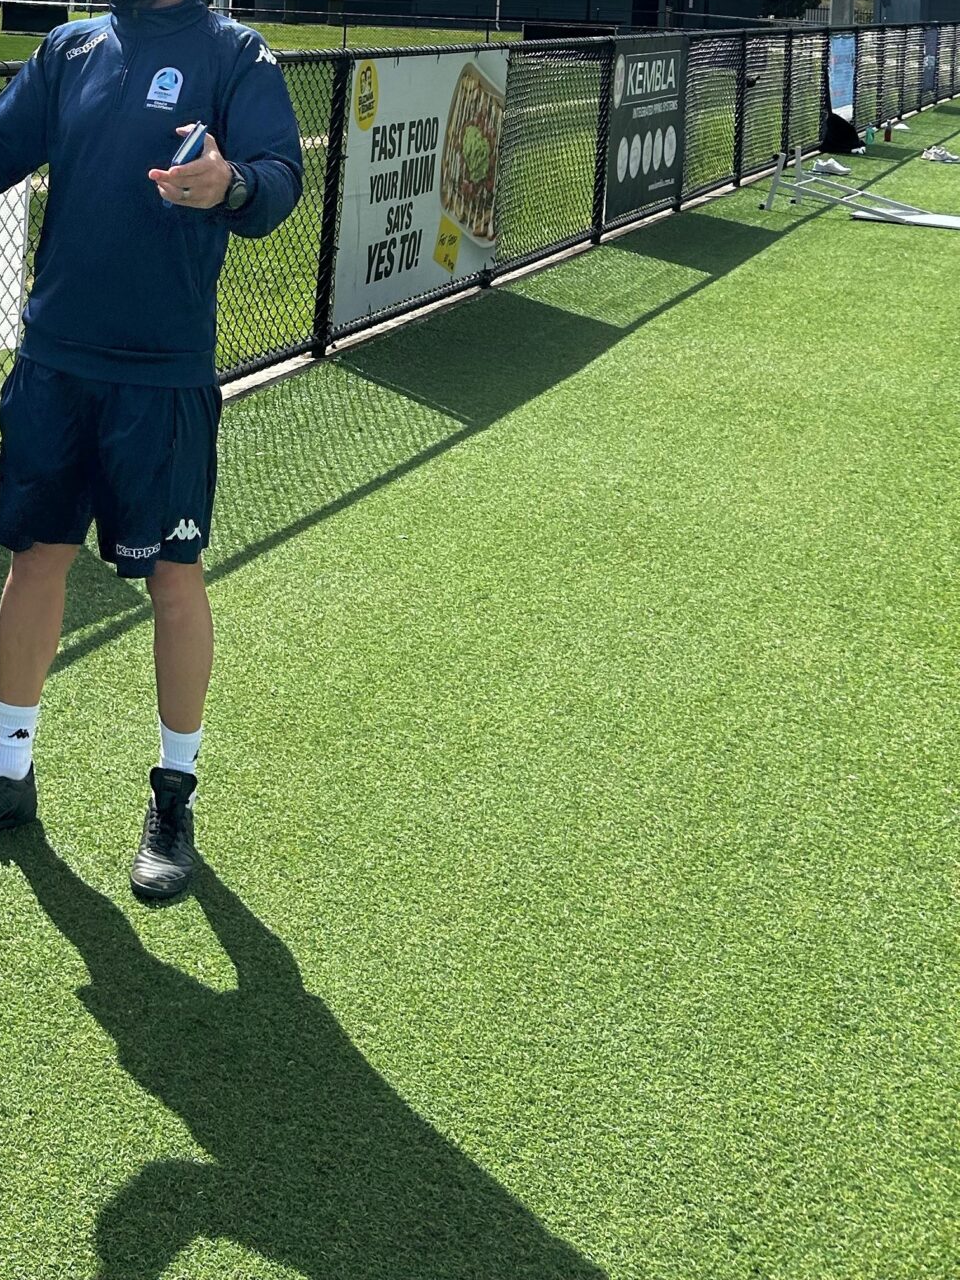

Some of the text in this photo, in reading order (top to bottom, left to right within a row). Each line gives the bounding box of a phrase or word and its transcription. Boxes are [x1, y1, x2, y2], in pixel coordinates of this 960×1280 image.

[66, 32, 108, 60] Kappa
[626, 58, 676, 96] KEMBLA
[371, 116, 439, 163] FAST FOOD
[370, 153, 436, 205] YOUR MUM
[385, 201, 413, 236] SAYS
[366, 229, 423, 285] YES TO!
[116, 542, 160, 559] Kappa
